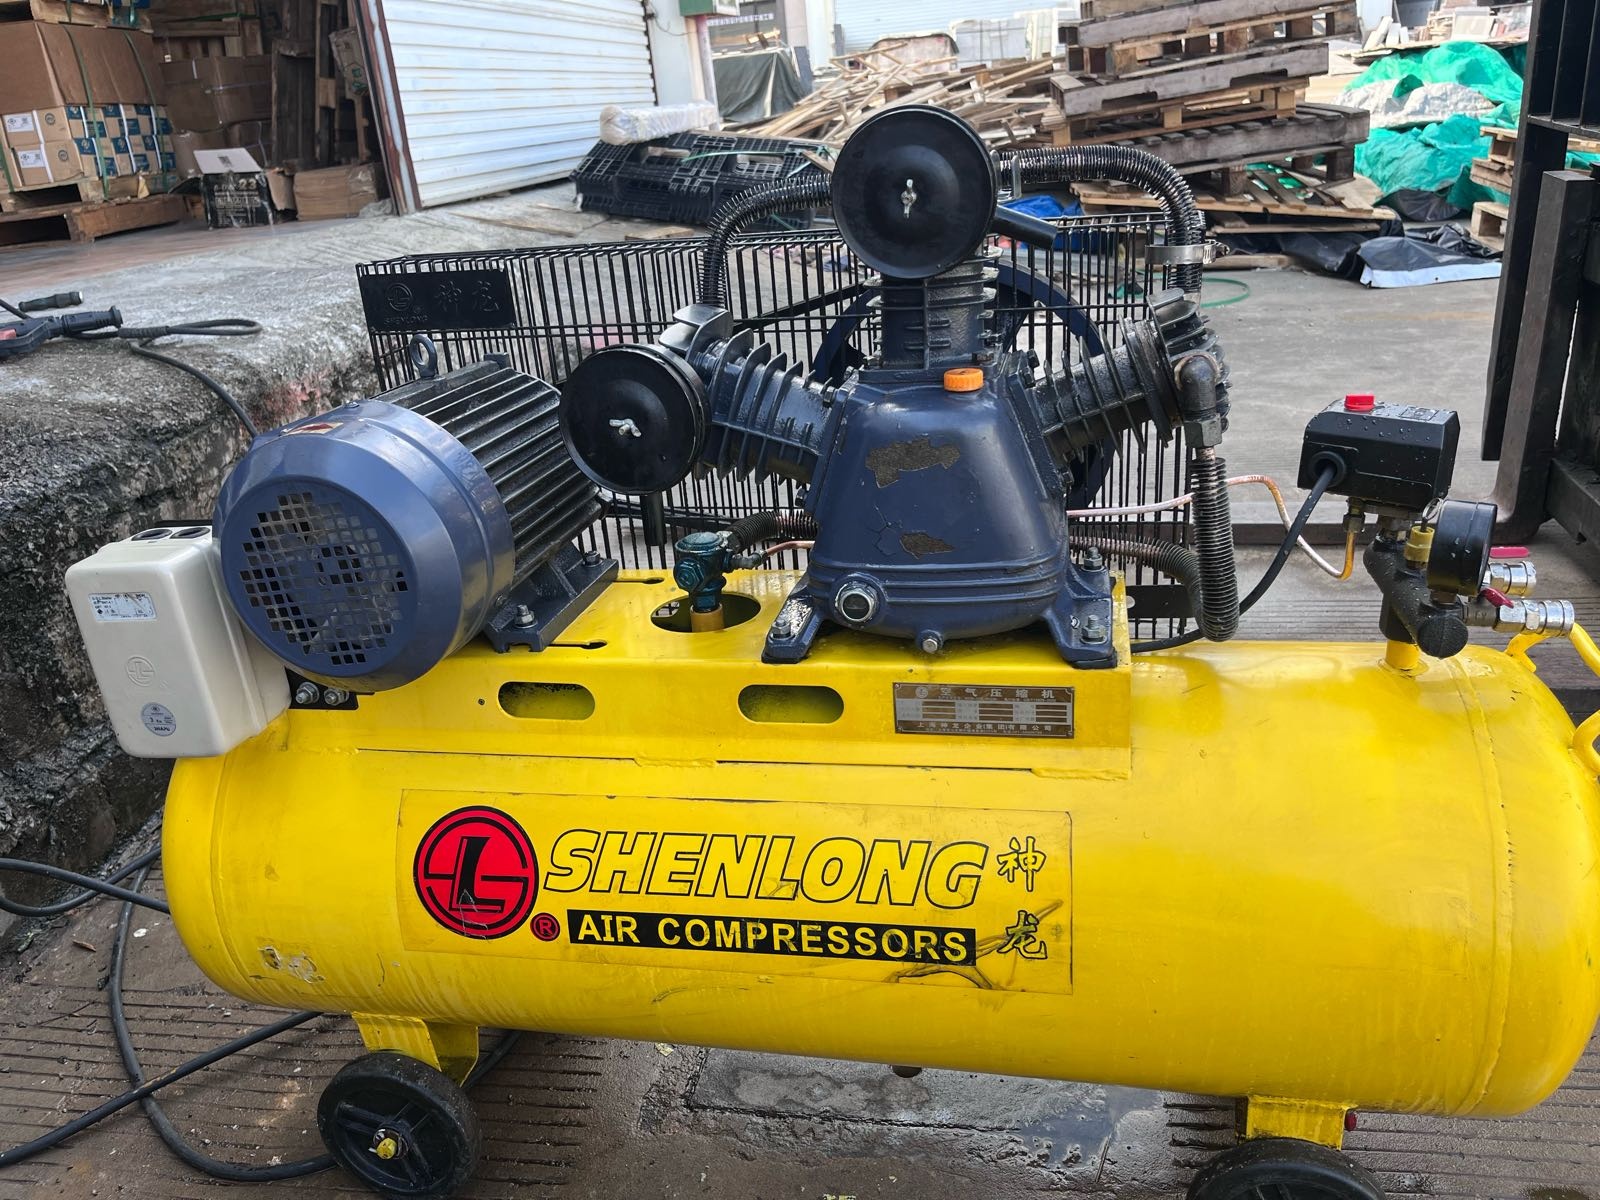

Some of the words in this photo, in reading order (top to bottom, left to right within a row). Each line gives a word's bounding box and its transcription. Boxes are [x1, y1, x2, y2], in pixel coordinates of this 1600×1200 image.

[940, 687, 1055, 699] 空气压缩机
[543, 829, 989, 909] SHENLONG
[577, 914, 641, 944] AIR
[657, 917, 968, 963] COMPRESSORS
